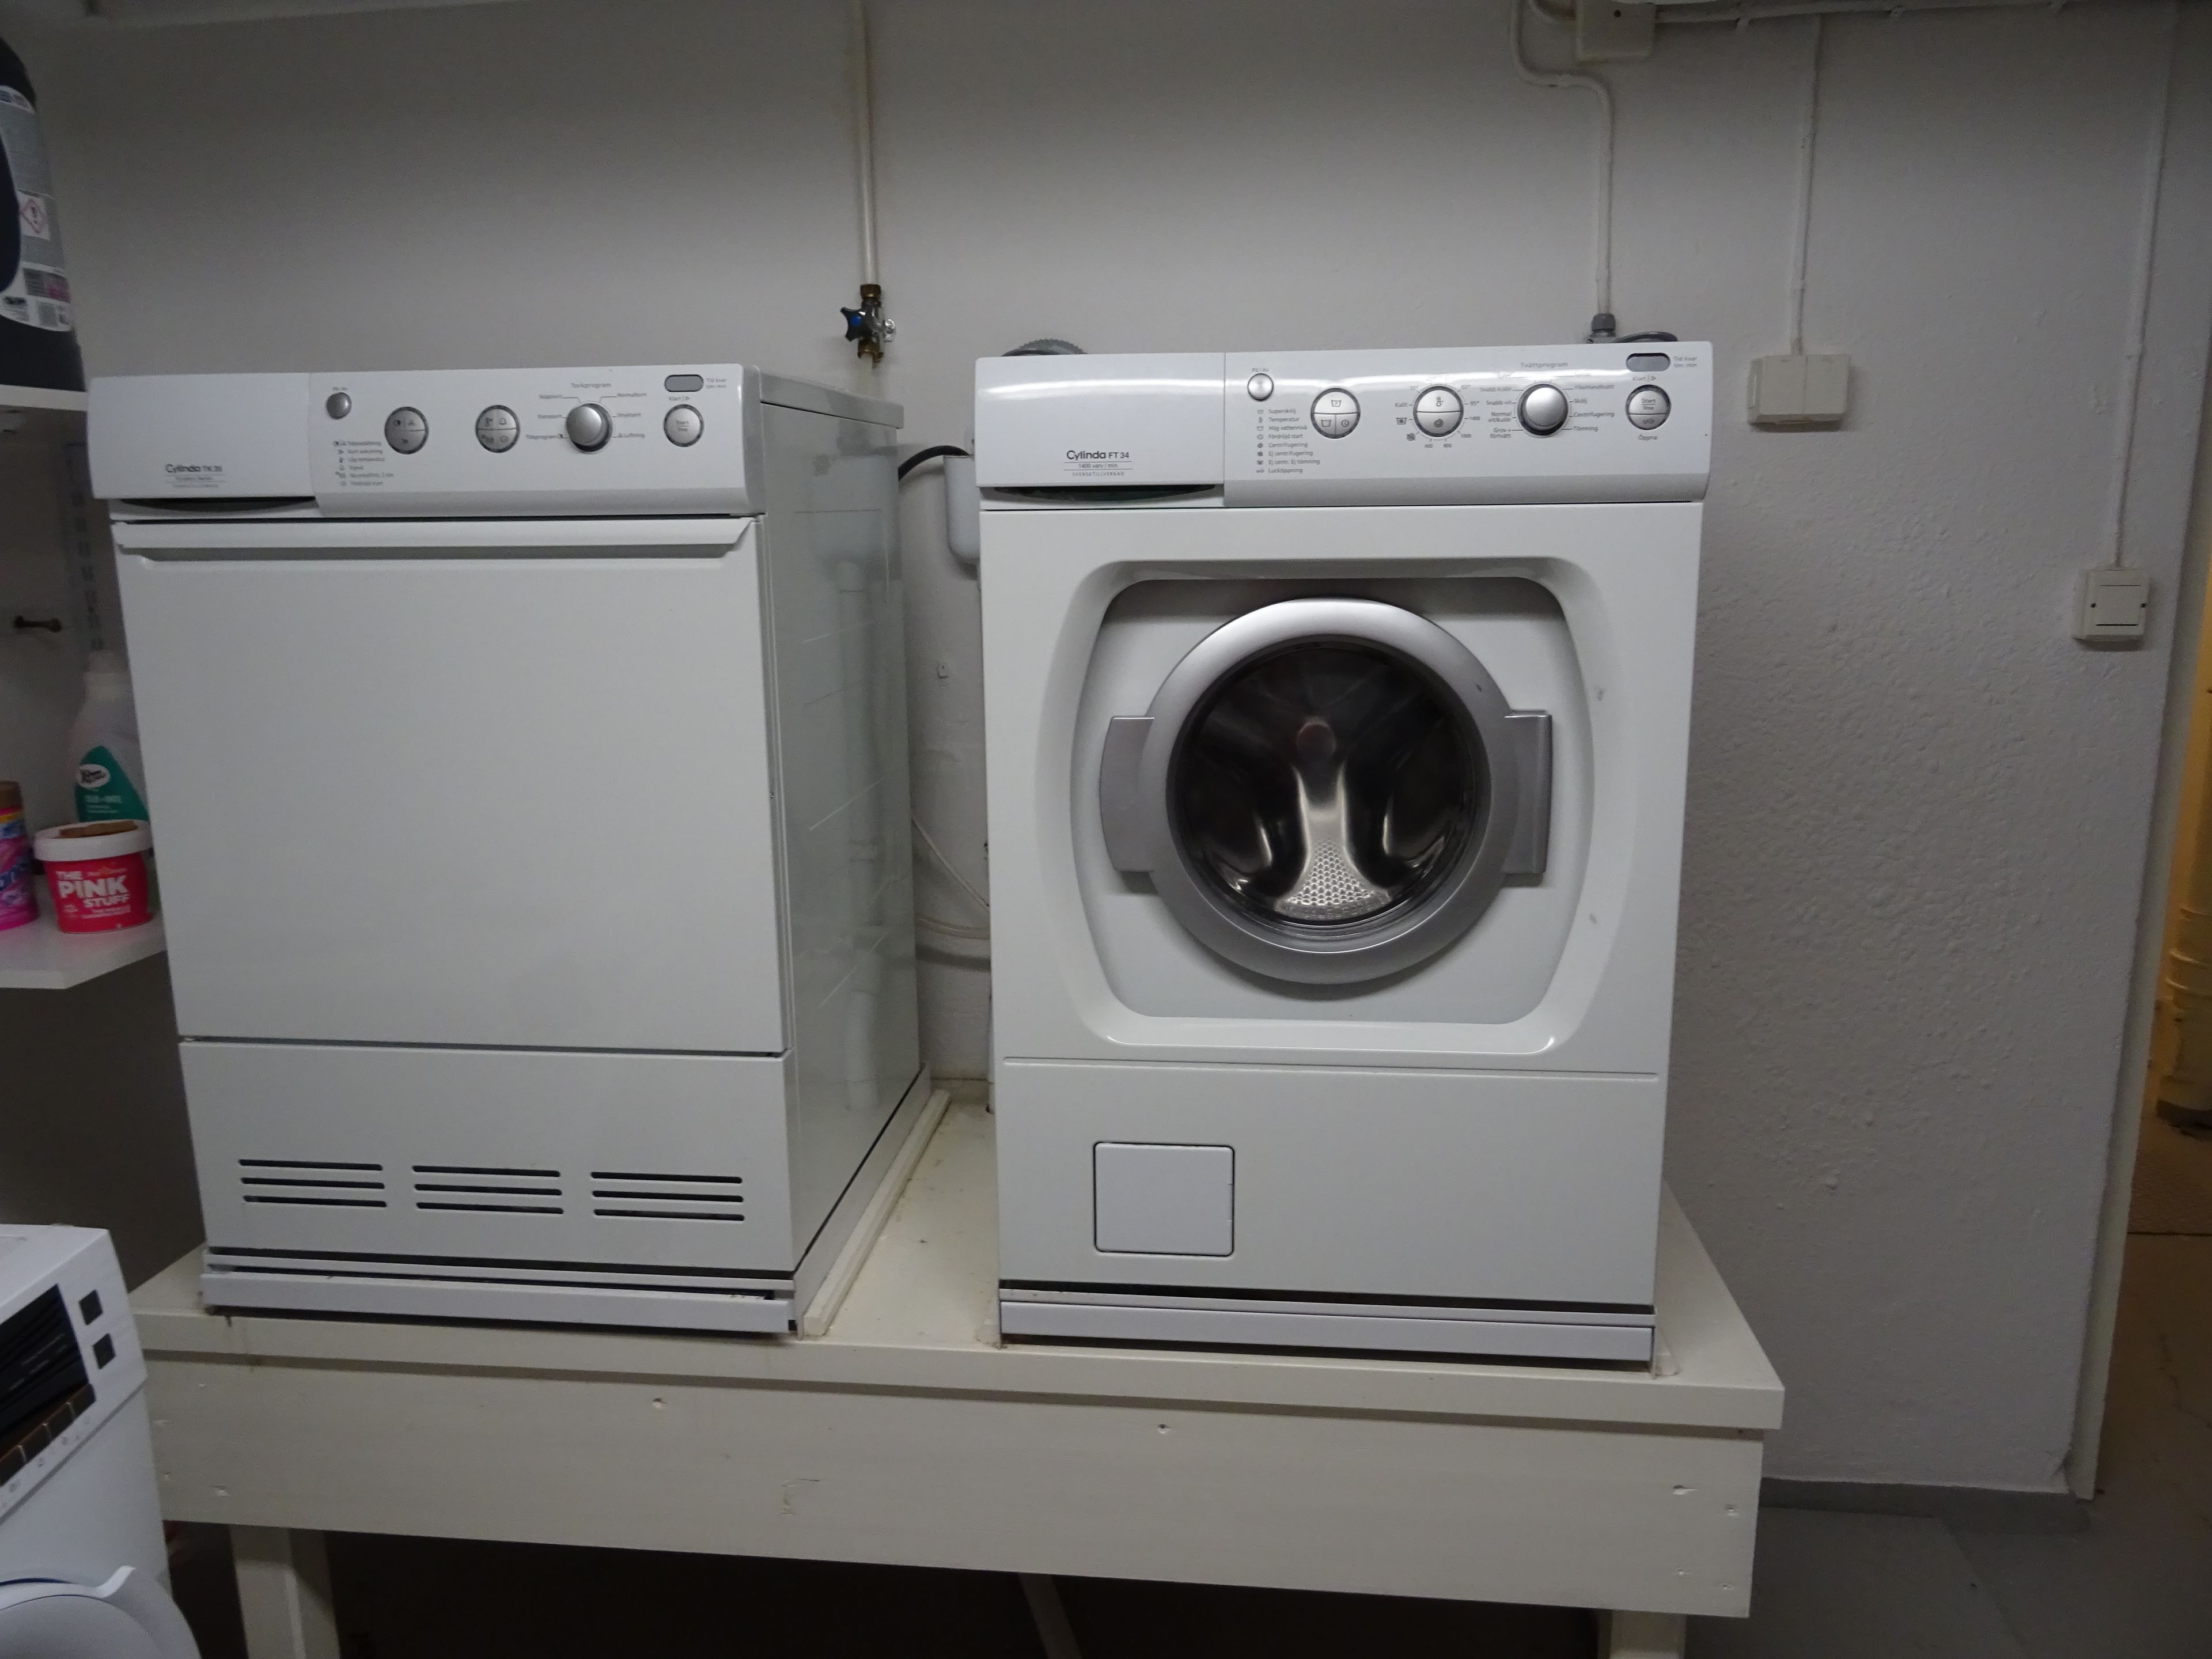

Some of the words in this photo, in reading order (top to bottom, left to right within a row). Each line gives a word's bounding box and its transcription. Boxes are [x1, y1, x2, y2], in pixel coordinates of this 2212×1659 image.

[1066, 450, 1107, 460] Cylinda
[56, 870, 84, 880] THE
[58, 875, 130, 899] PINK
[83, 893, 130, 908] STUFF
